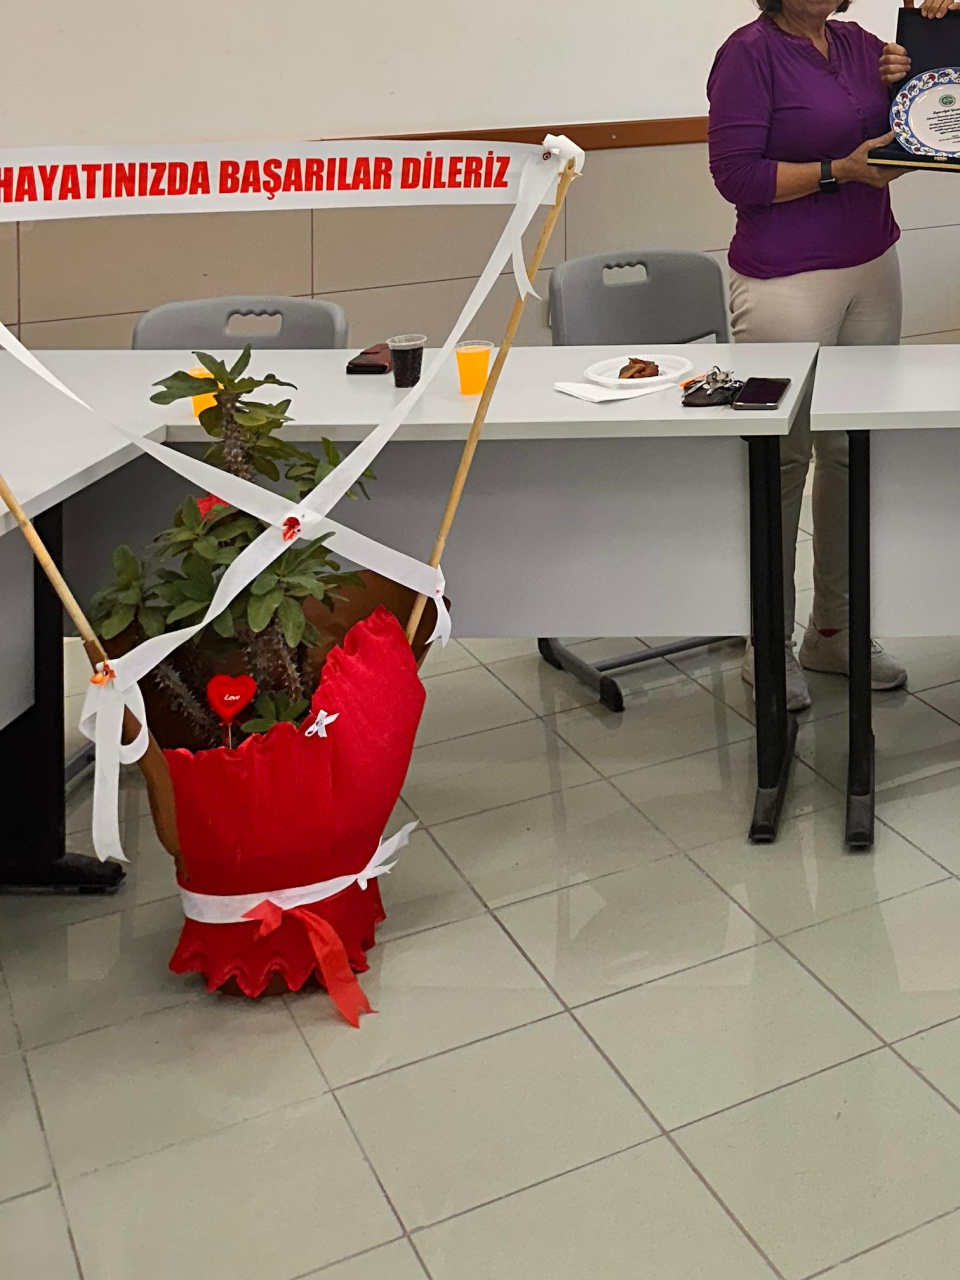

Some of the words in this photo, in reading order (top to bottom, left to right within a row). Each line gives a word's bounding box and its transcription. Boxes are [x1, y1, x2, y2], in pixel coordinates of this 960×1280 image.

[0, 160, 211, 204] HAYATINIZDA
[218, 156, 393, 201] BAŞARILAR
[400, 150, 511, 190] DİLERİZ
